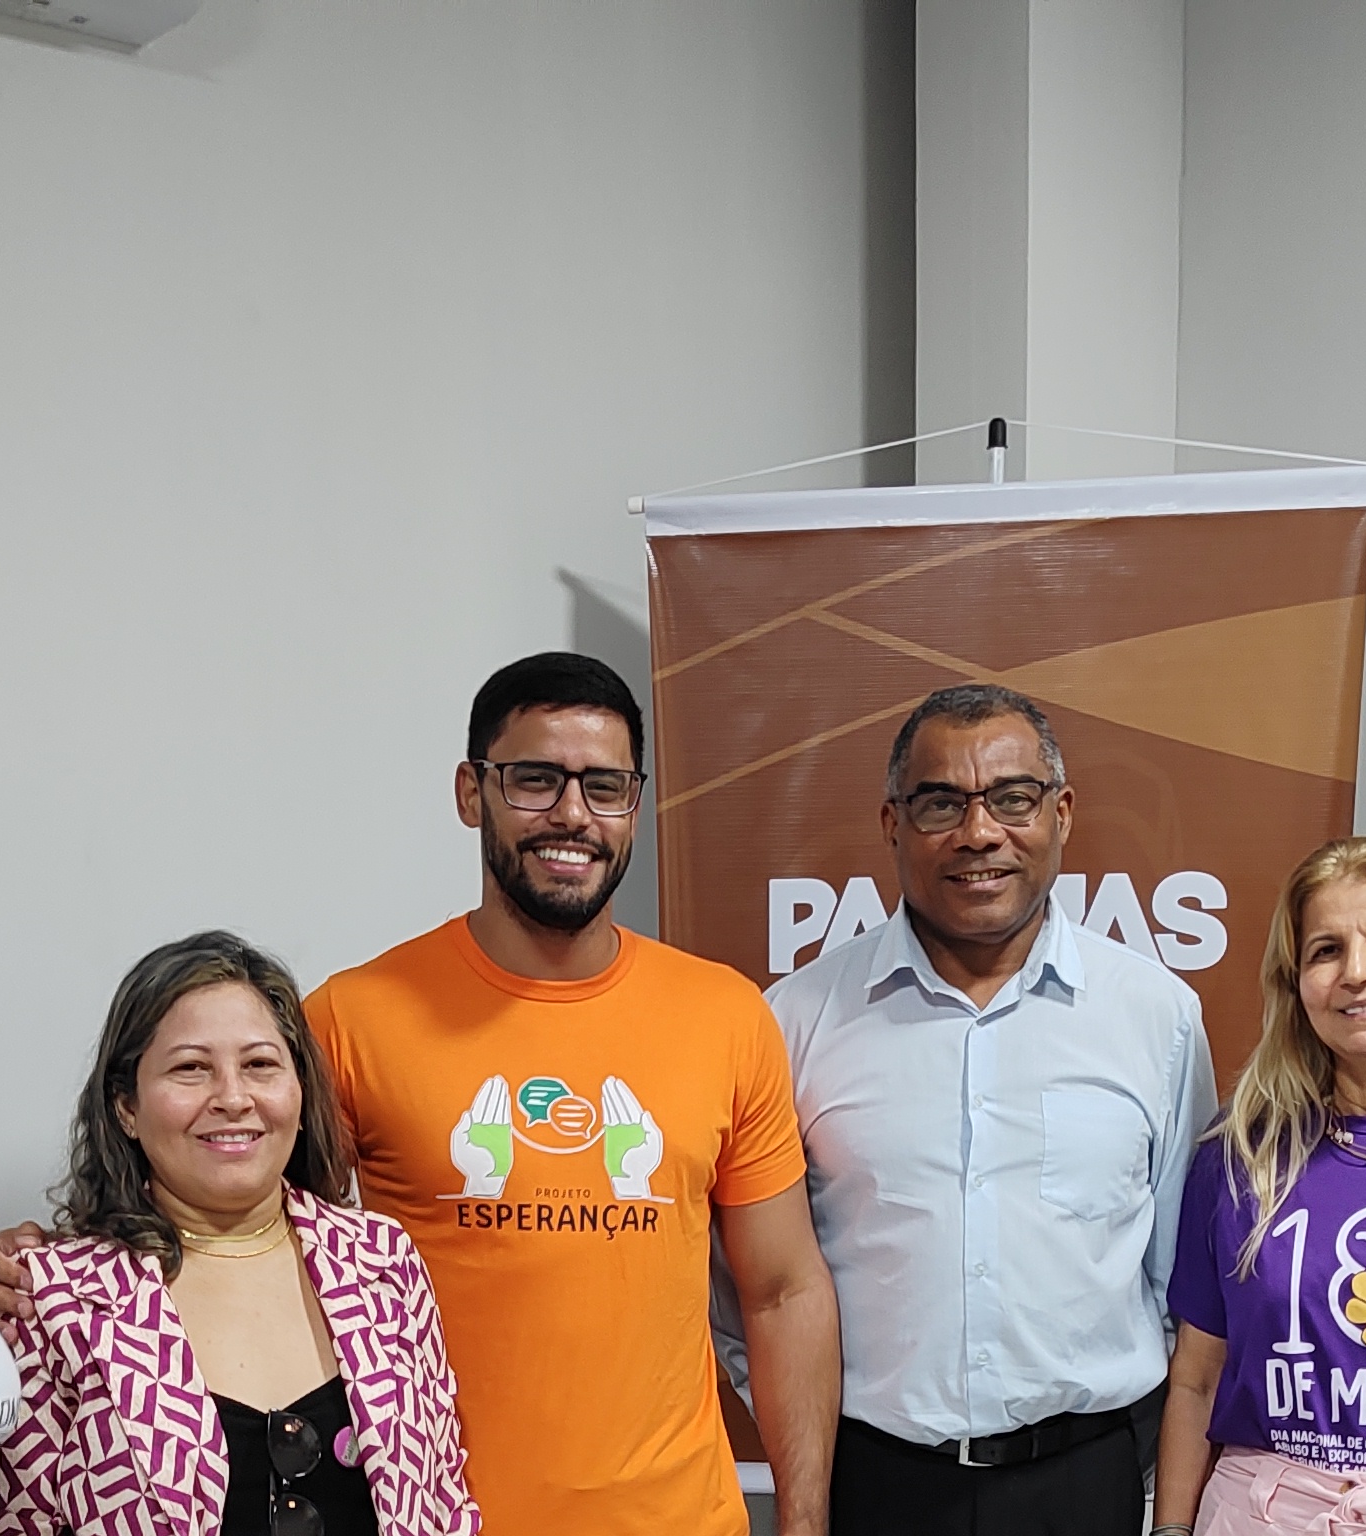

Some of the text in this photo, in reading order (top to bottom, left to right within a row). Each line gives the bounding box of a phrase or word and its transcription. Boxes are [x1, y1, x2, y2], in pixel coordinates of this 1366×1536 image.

[768, 871, 1228, 974] PAAS
[535, 1187, 591, 1199] PROJETO
[456, 1203, 659, 1241] ESPERANÇAR
[1265, 1358, 1315, 1421] DE
[1270, 1429, 1290, 1443] DIA
[1291, 1429, 1346, 1448] NACONAL
[1346, 1436, 1363, 1450] DE
[1311, 1445, 1320, 1459] E
